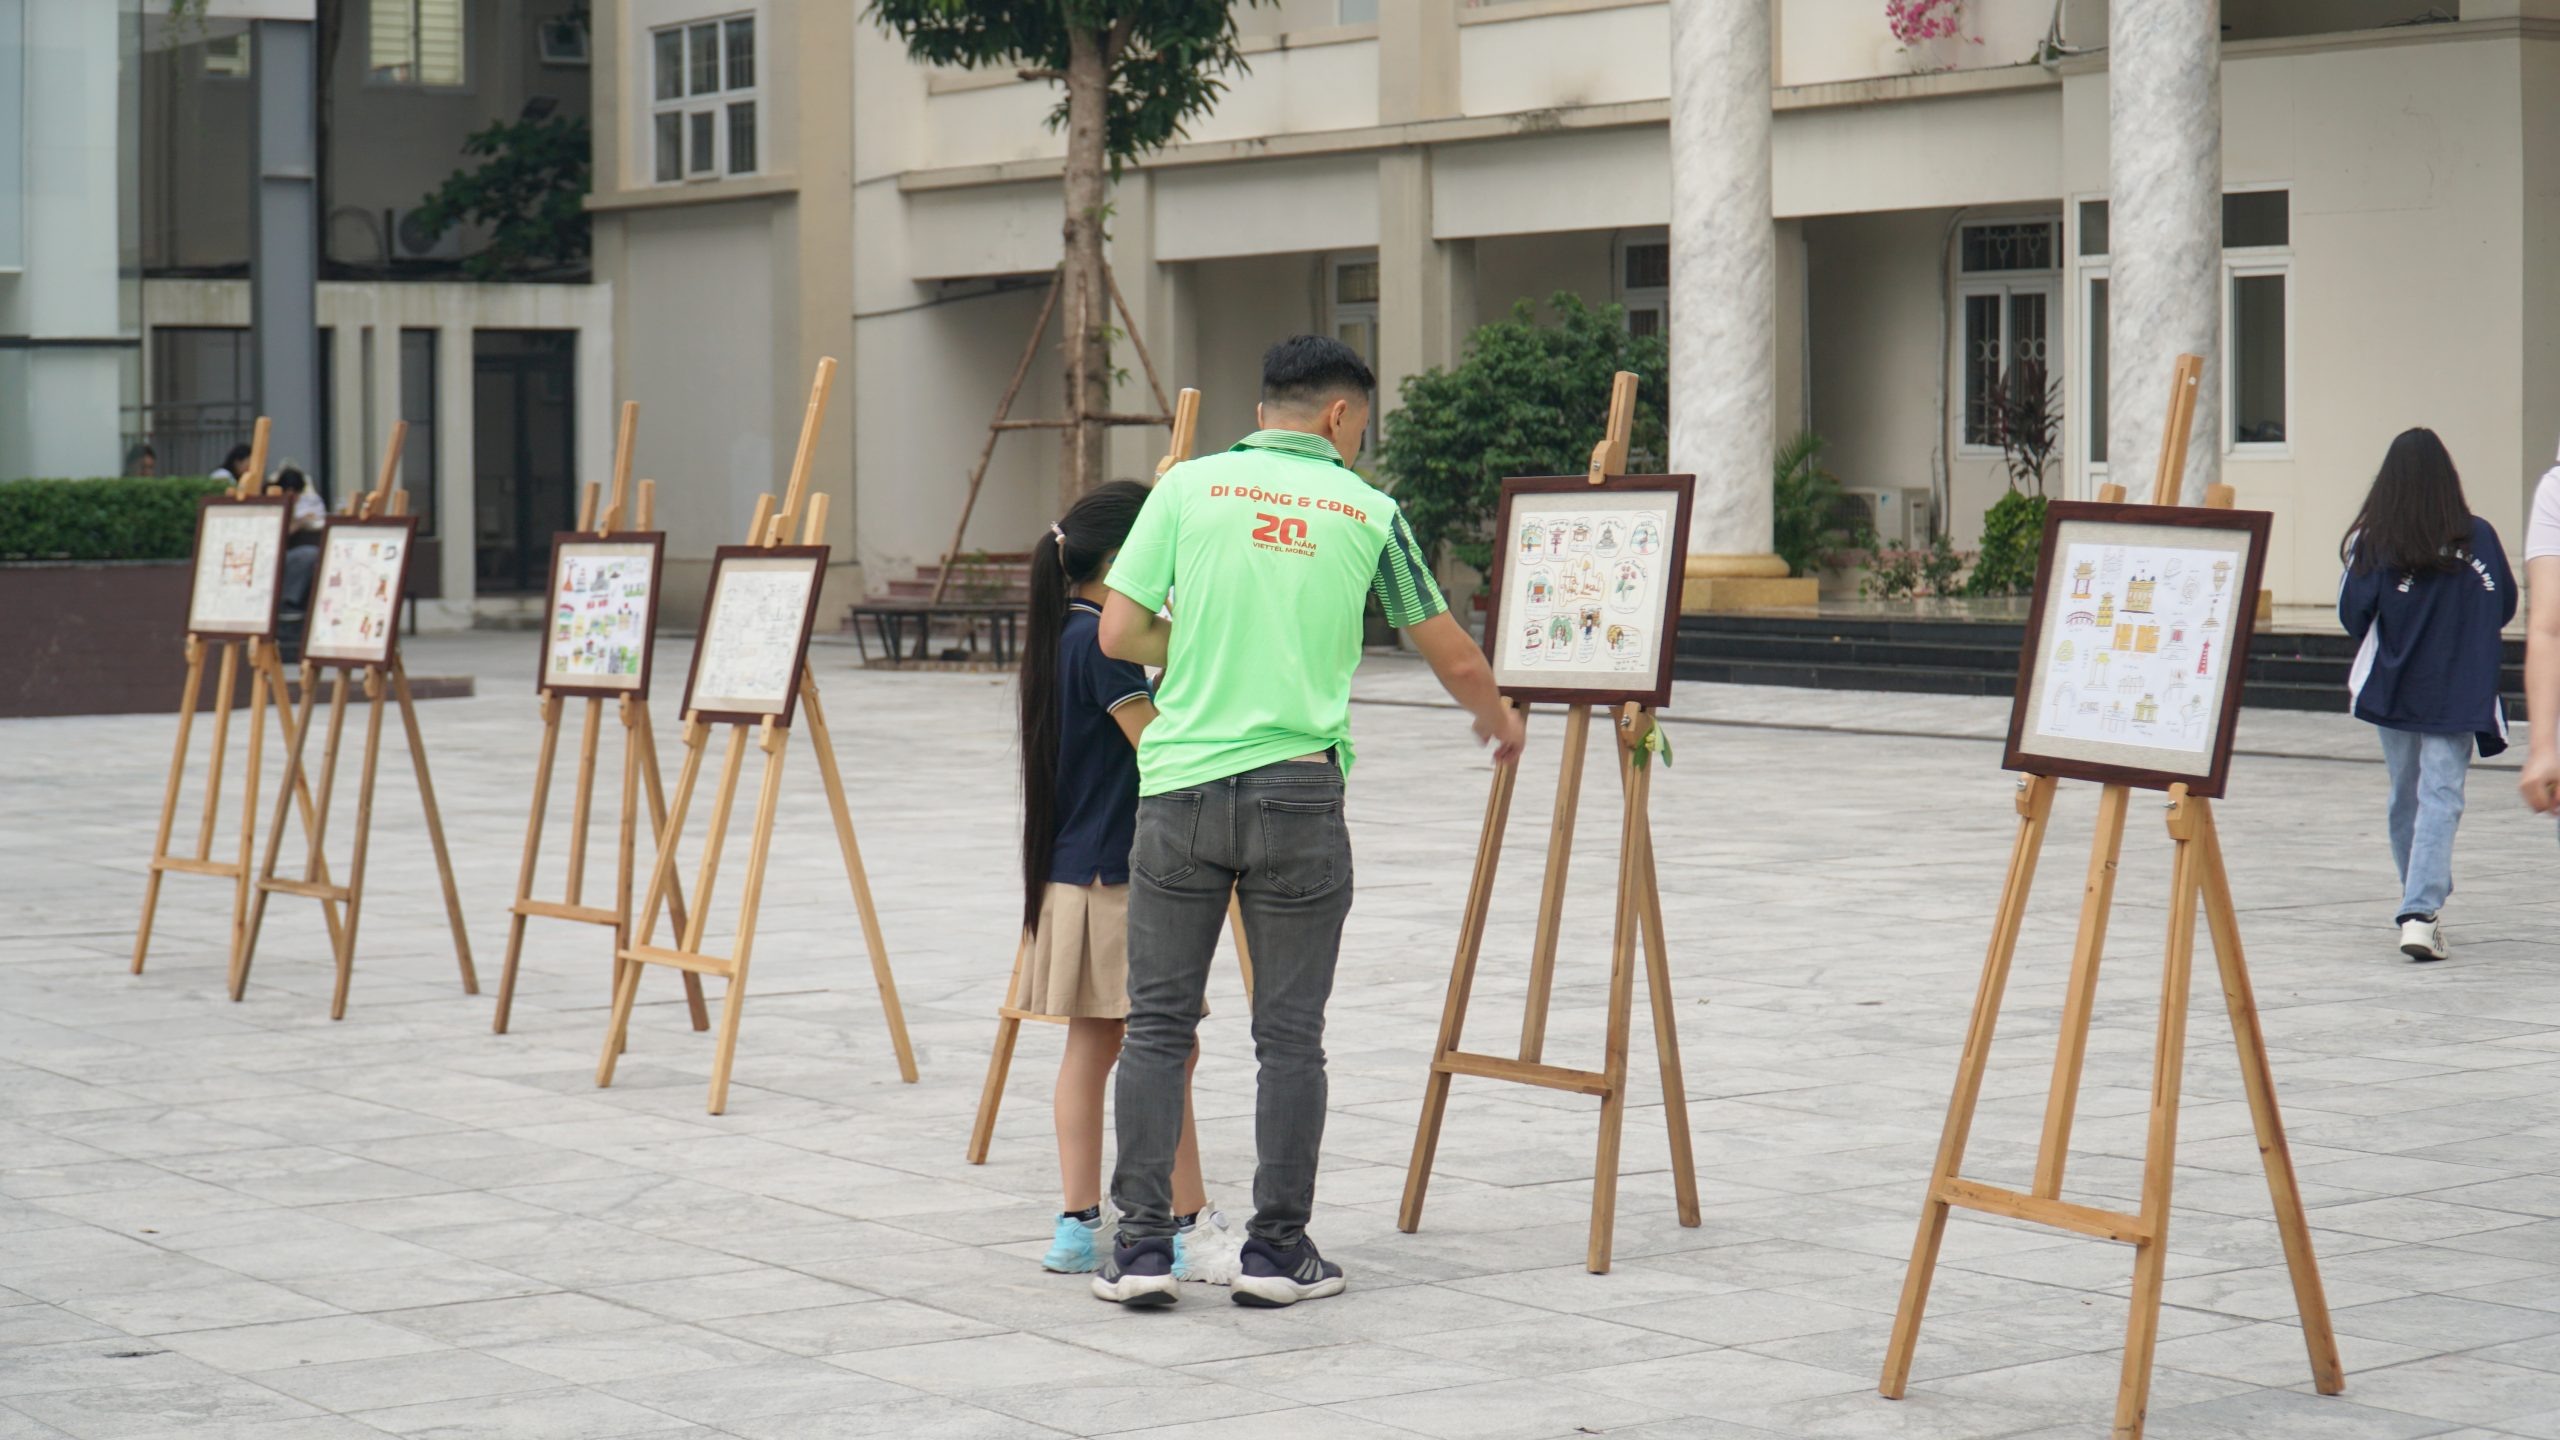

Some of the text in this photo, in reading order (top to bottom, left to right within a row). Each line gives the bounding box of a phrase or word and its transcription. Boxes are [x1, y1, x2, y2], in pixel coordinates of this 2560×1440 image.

[1210, 485, 1367, 524] DI ĐỘNG & CĐBR
[1252, 512, 1308, 545] 20
[1252, 541, 1316, 558] VIETTEL MOBILE
